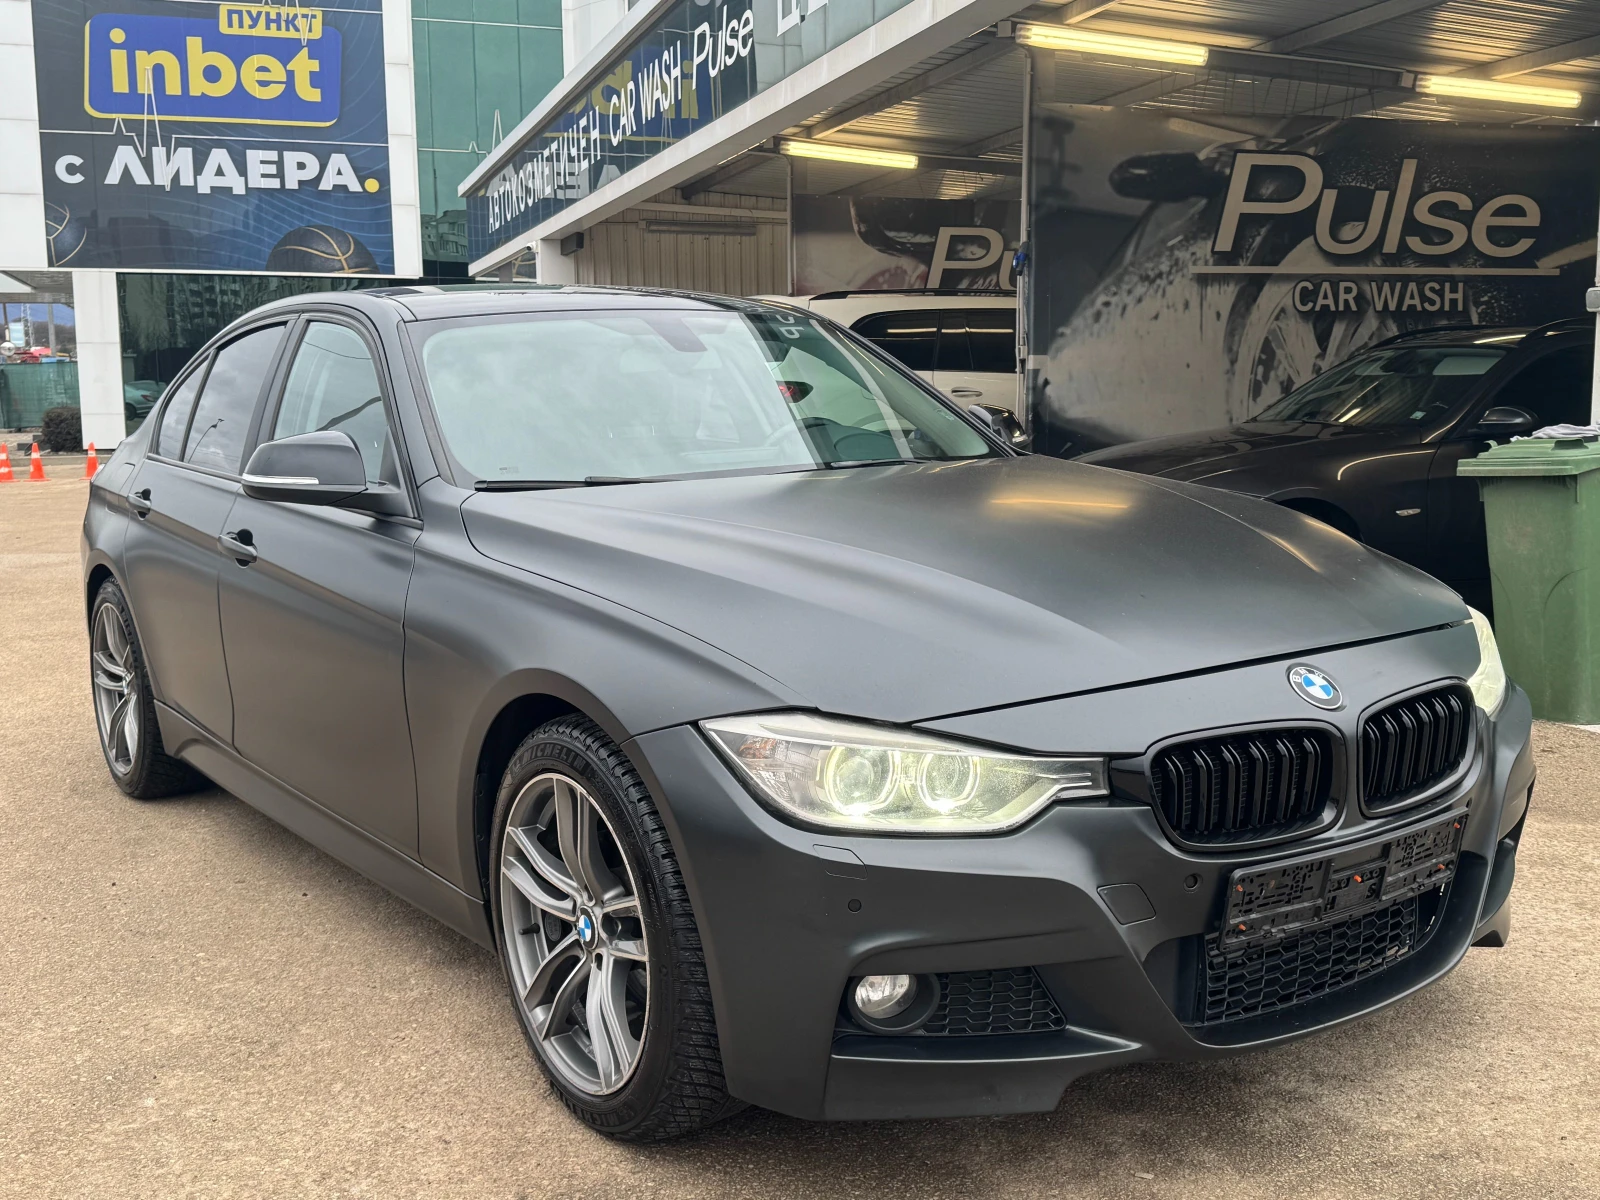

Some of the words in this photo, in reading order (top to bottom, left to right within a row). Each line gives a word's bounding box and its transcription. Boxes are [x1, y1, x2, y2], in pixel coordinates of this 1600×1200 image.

[227, 9, 318, 33] ПУНКТ
[109, 28, 322, 102] inbet
[488, 105, 601, 234] АВТОКОЗМЕТИЧЕН
[609, 80, 637, 147] CAR
[638, 40, 682, 125] WASH
[692, 4, 754, 90] Pulse
[54, 154, 85, 184] с
[104, 145, 380, 195] ЛИДЕРА.
[1211, 152, 1541, 258] Pulse
[1293, 281, 1358, 312] CAR
[1370, 282, 1464, 312] WASH
